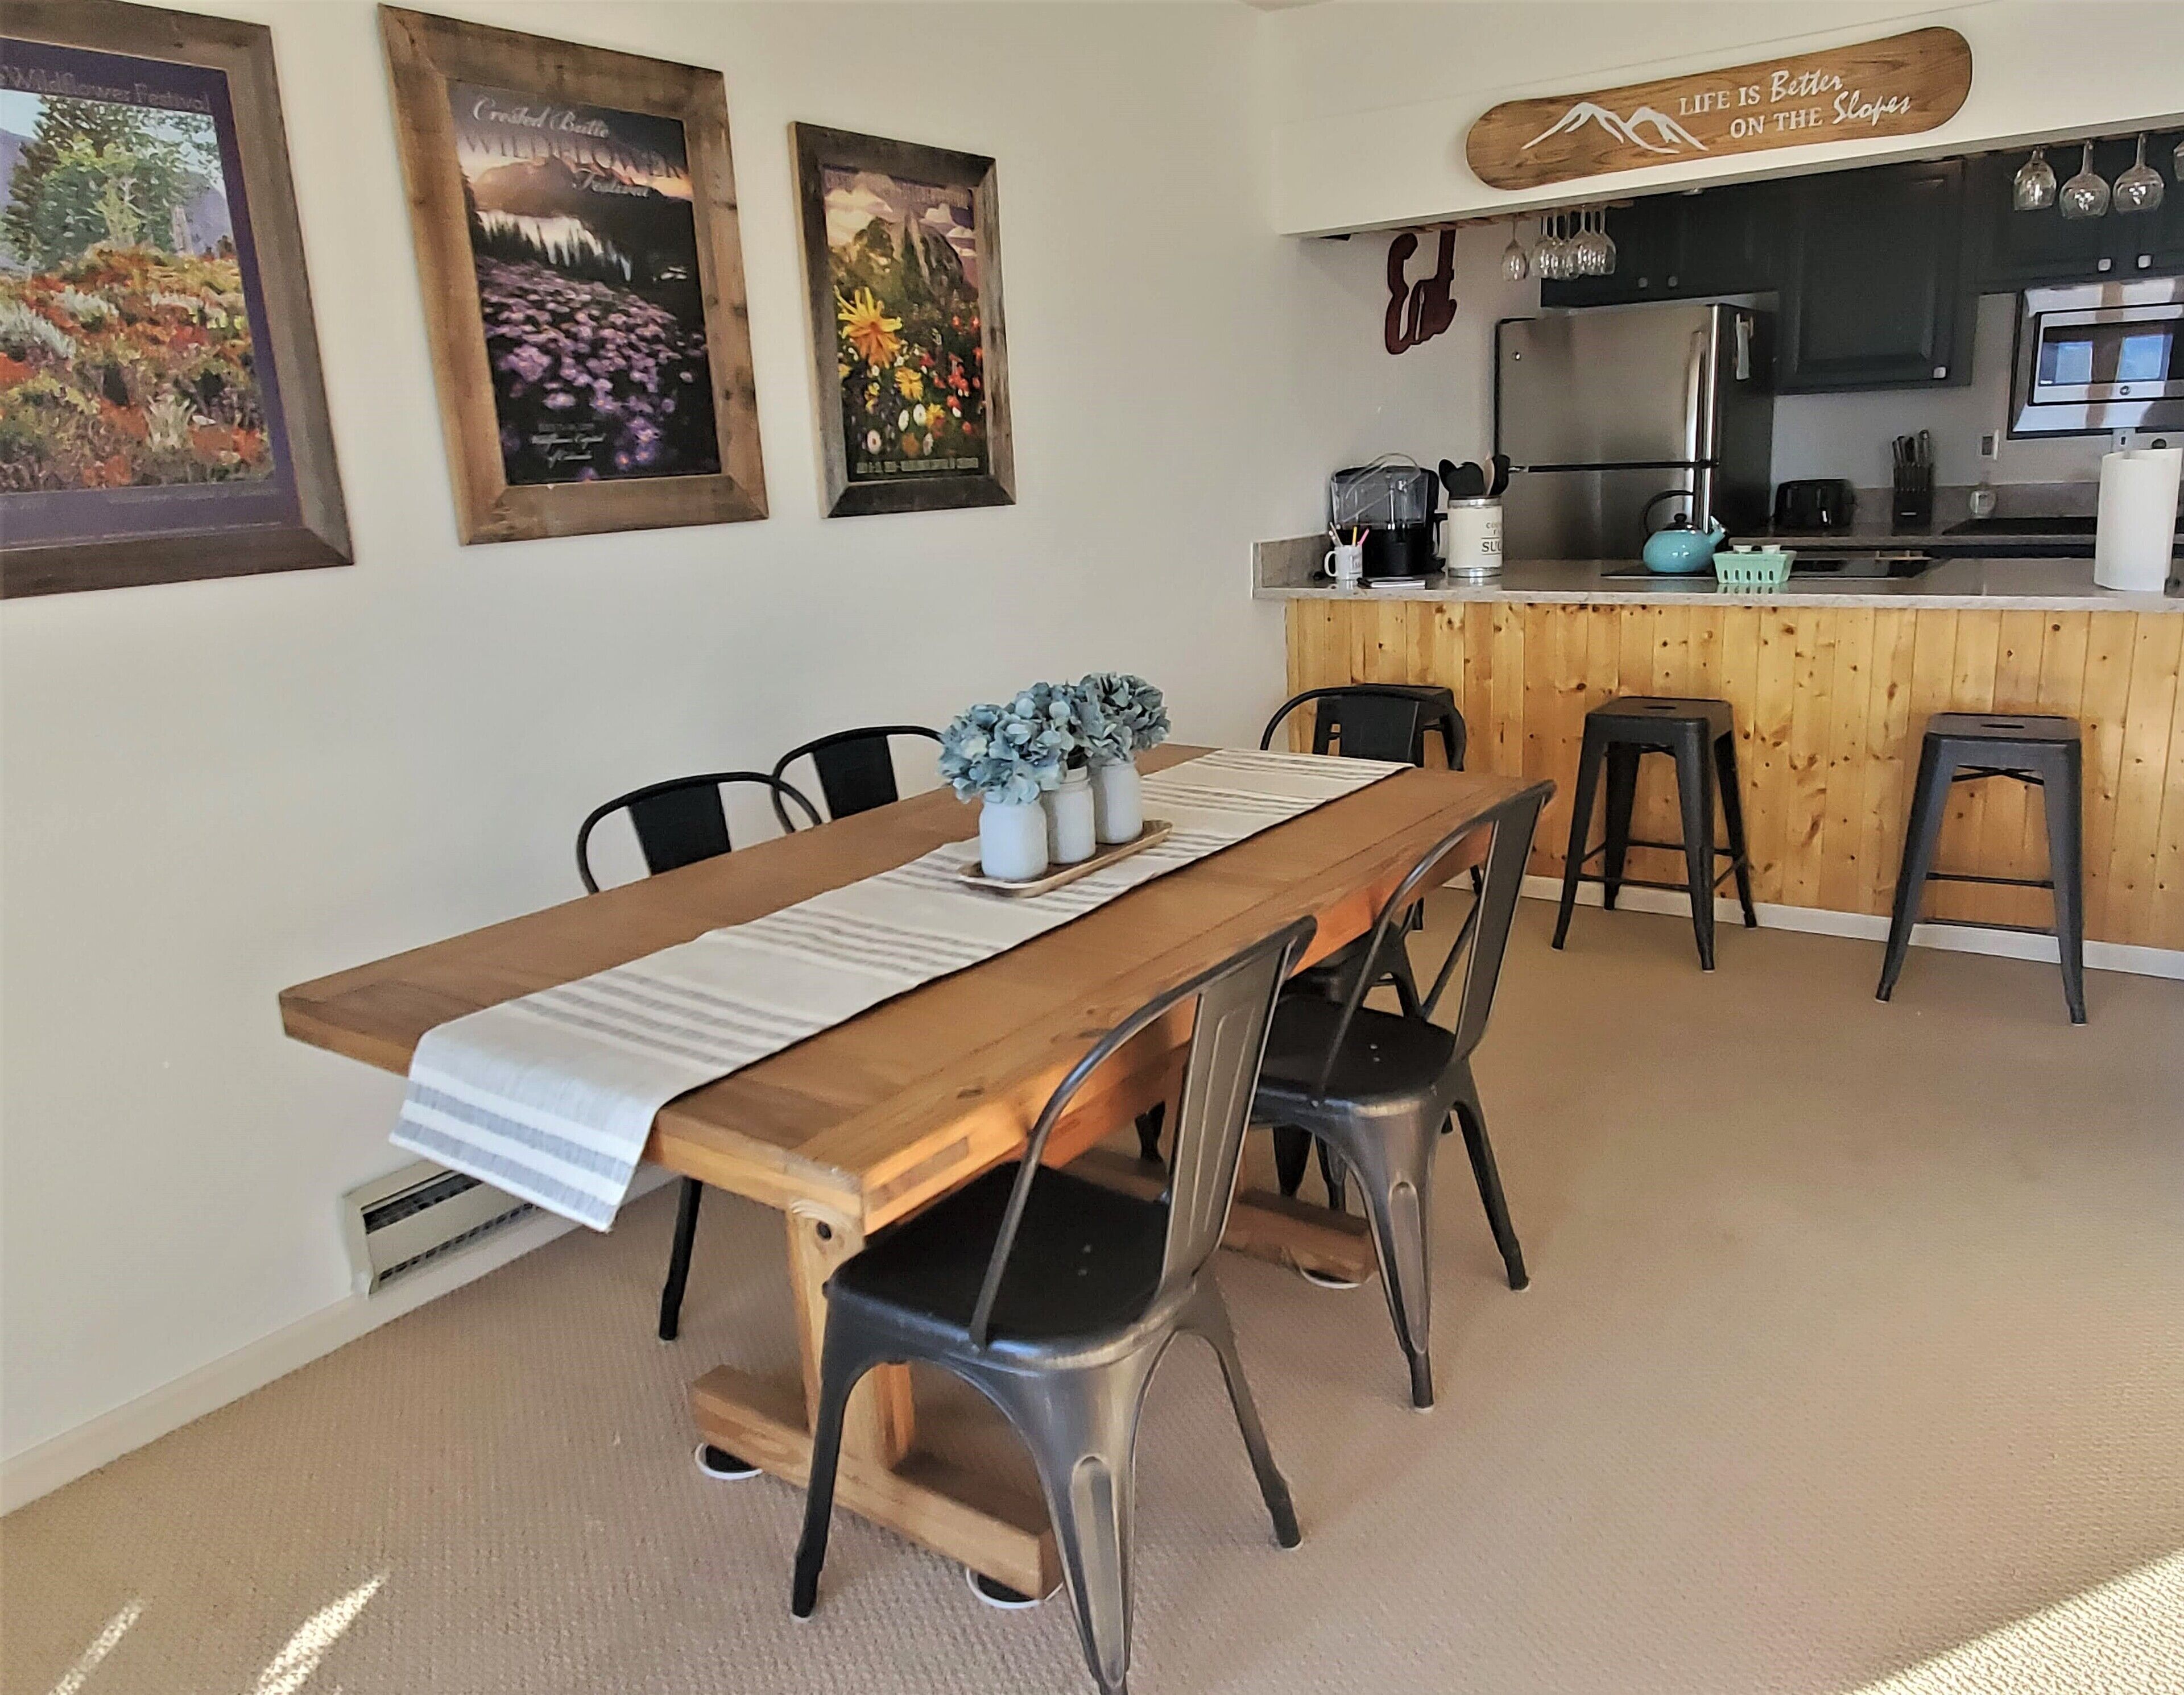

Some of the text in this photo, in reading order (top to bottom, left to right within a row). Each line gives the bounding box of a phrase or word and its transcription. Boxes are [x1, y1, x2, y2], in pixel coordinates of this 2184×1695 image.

[1680, 69, 1843, 116] LIFE IS Better
[1730, 90, 1912, 139] ON THE Slopes
